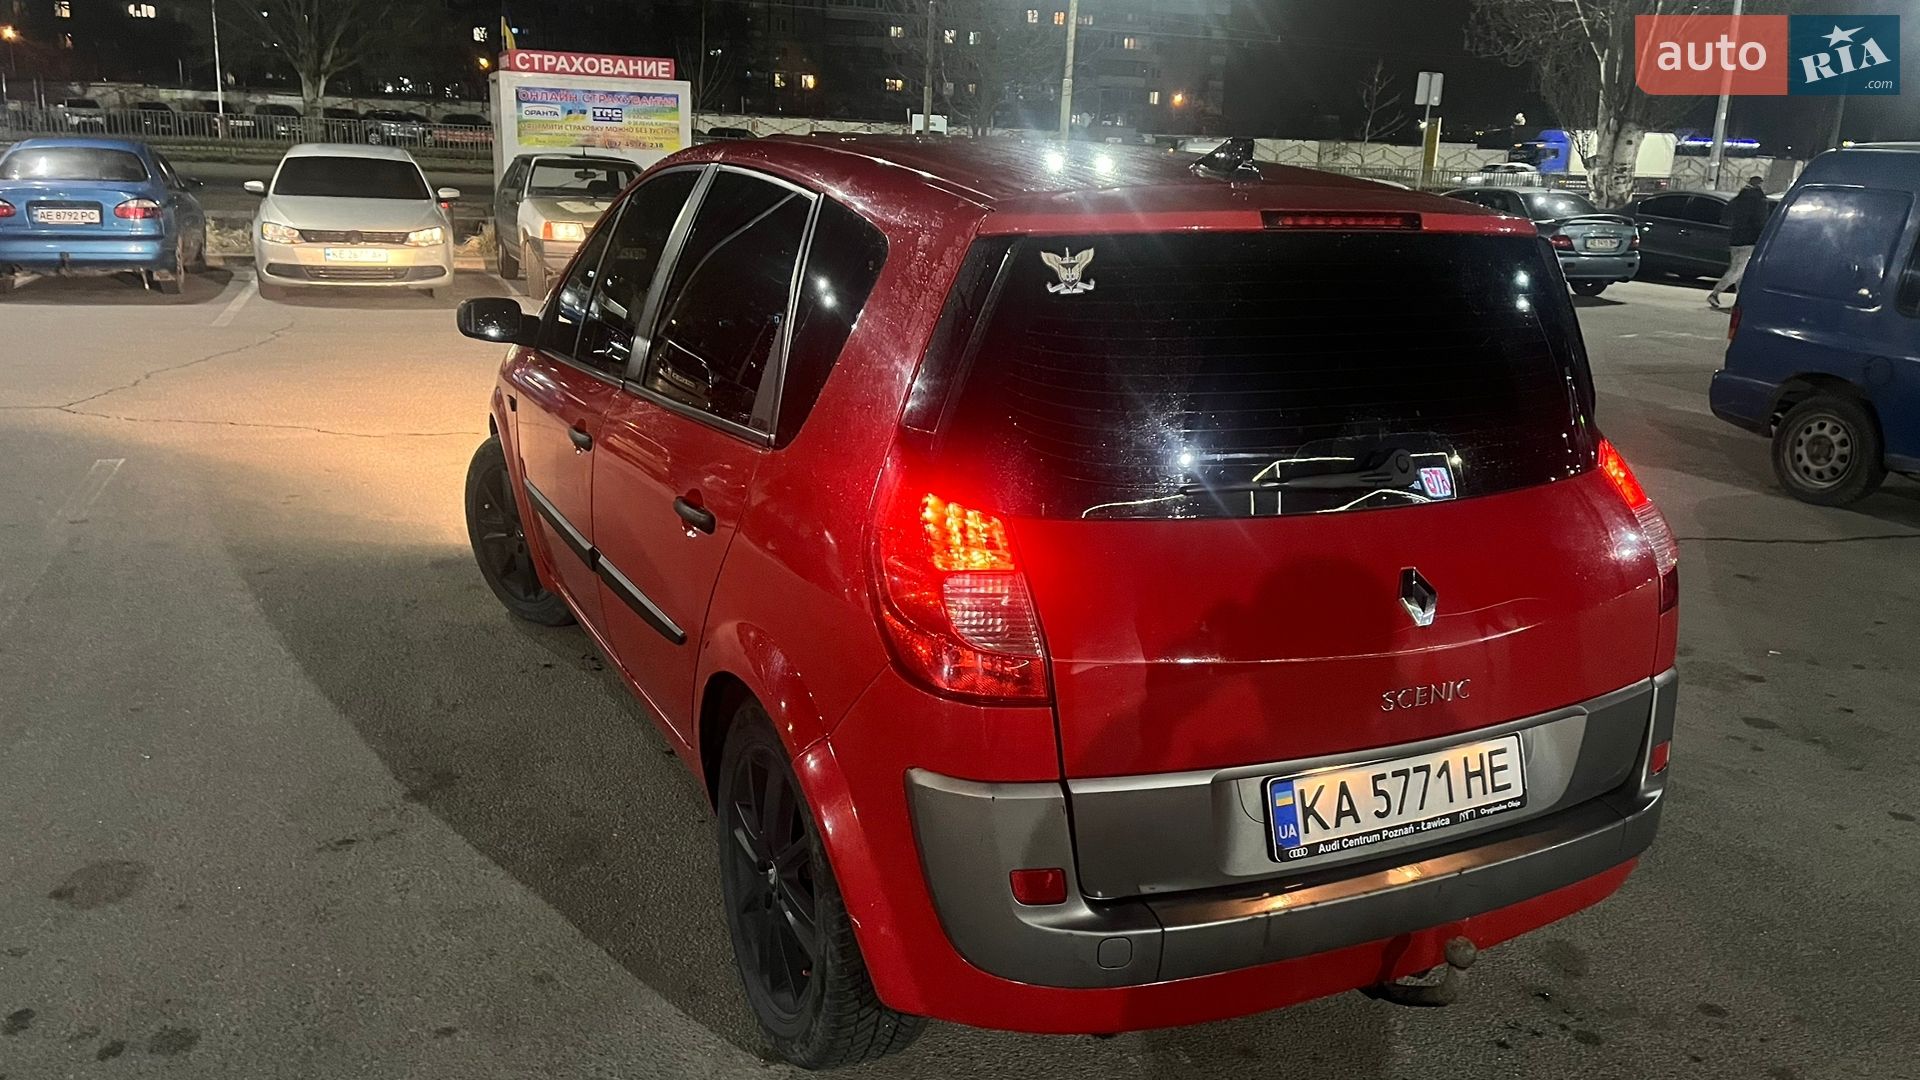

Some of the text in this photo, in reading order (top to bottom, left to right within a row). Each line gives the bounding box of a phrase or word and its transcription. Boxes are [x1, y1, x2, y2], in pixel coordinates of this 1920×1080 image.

[515, 53, 671, 78] СТРАХОВАНИЕ
[518, 86, 578, 103] ОНЛАЙН
[524, 109, 560, 117] ОРАНТА
[40, 211, 96, 220] AE 8792 PC
[1381, 679, 1471, 712] SCENIC
[1299, 747, 1512, 834] KA 5771 HE
[1279, 825, 1298, 840] UA
[1318, 841, 1340, 854] Audi
[1342, 832, 1381, 848] Centrum
[1382, 823, 1415, 840] Poznań
[1420, 816, 1451, 831] Ławica
